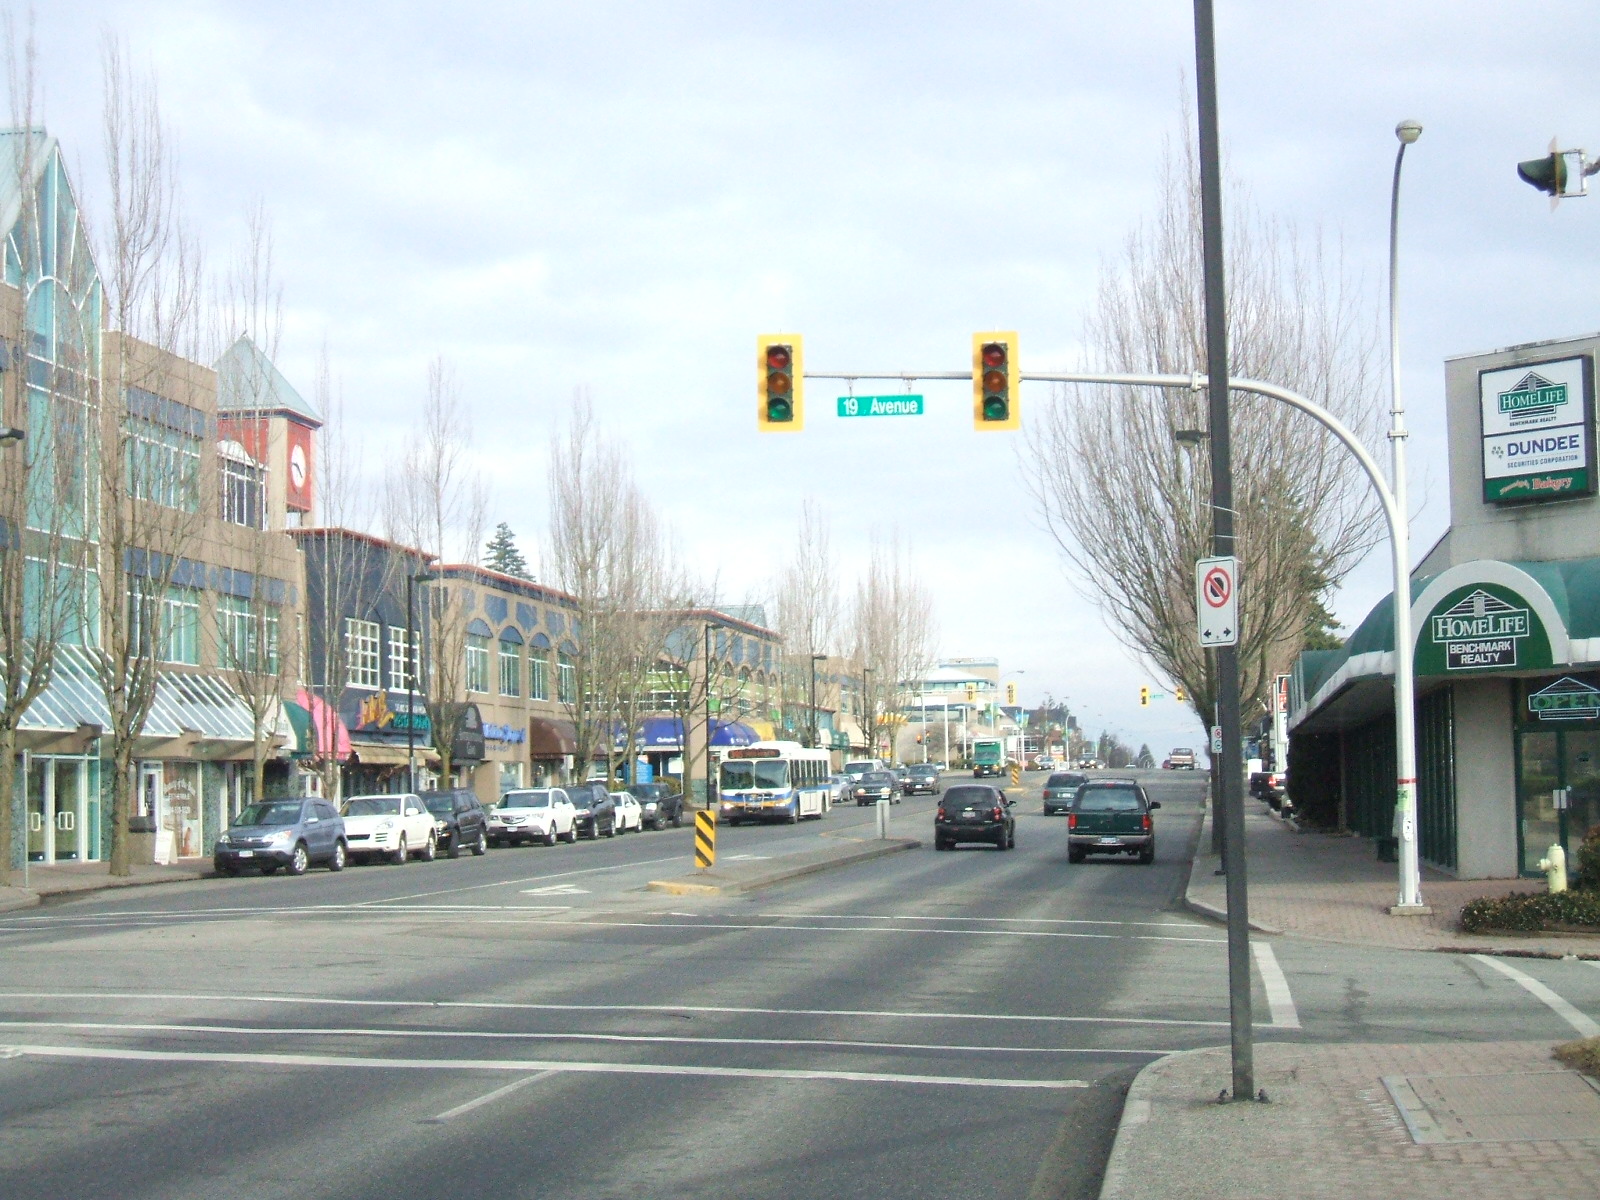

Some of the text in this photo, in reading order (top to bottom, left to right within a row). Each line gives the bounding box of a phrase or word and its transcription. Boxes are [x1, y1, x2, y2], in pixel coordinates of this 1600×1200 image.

[843, 397, 918, 415] 19 Avenue
[1509, 416, 1557, 427] BENCHMARK REALTY
[1507, 434, 1580, 457] DUNDEE
[1507, 454, 1579, 469] SECURITIES CORPORATION
[1449, 640, 1512, 654] BENCHMARK
[1460, 653, 1500, 664] REALTY
